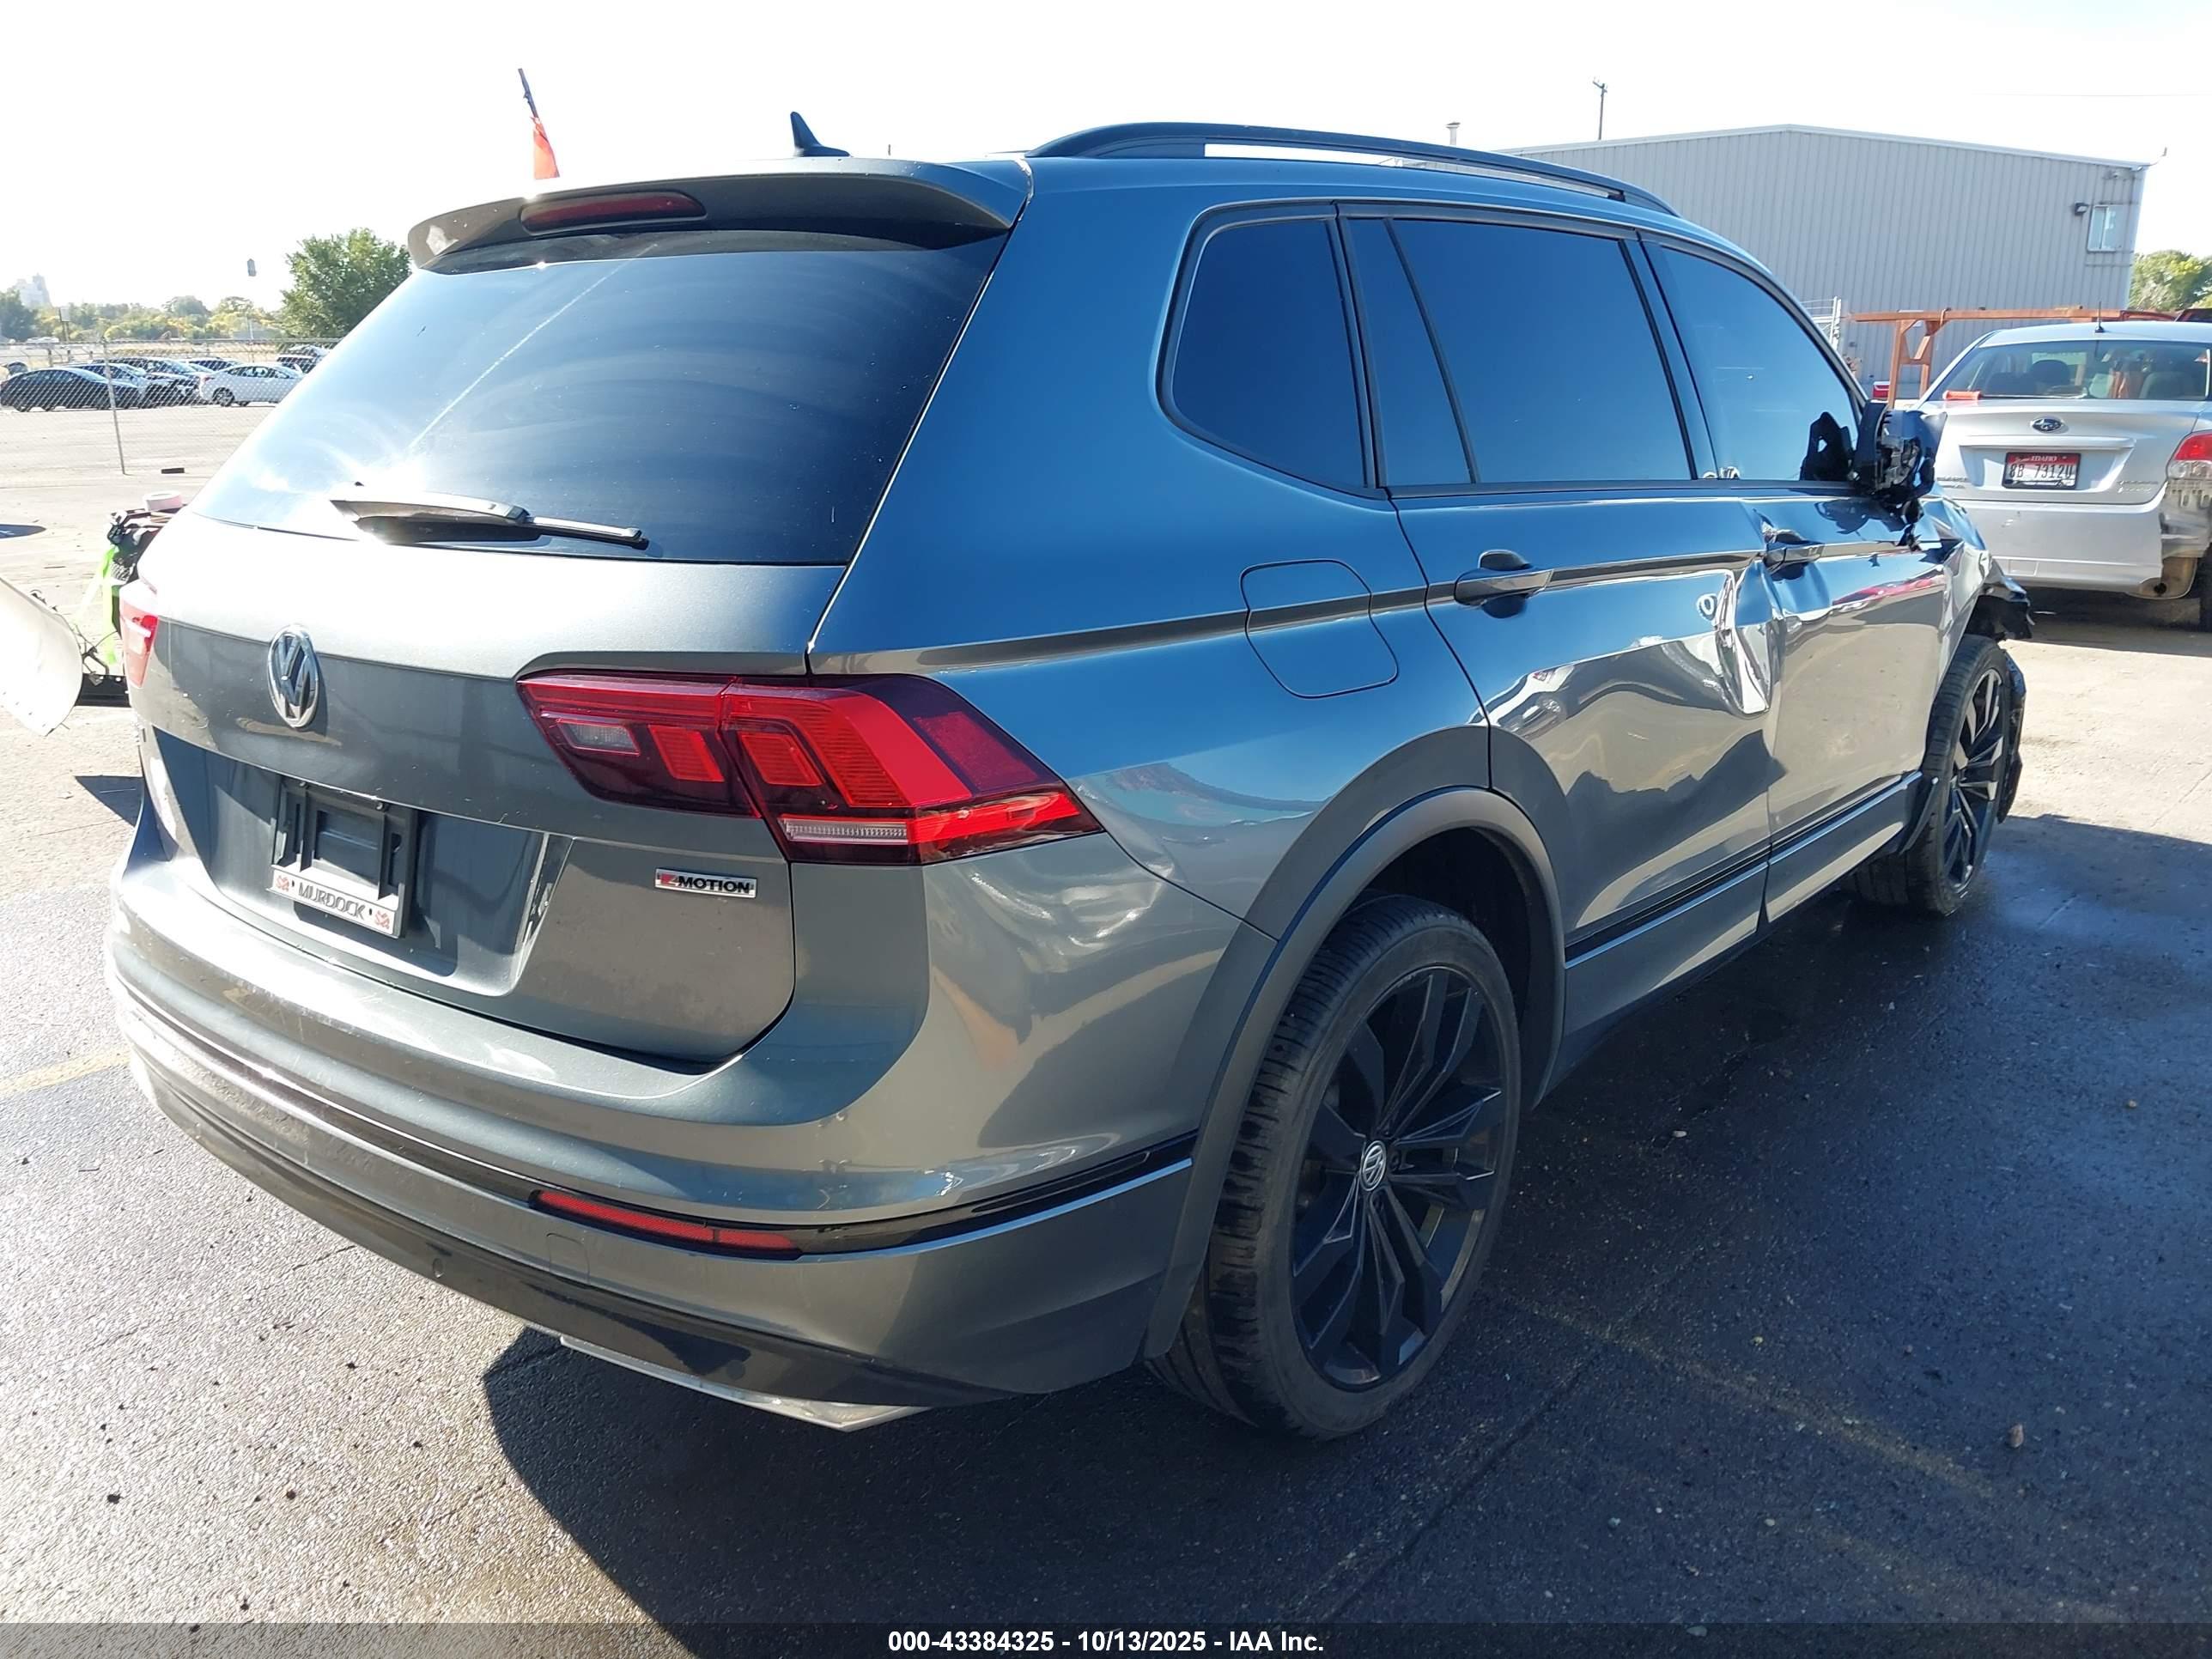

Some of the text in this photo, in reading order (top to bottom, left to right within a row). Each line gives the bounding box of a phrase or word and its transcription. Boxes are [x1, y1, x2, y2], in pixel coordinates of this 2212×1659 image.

[2010, 464, 2025, 478] 8B
[660, 873, 750, 894] 4MOTION
[298, 881, 367, 921] MURDOCK
